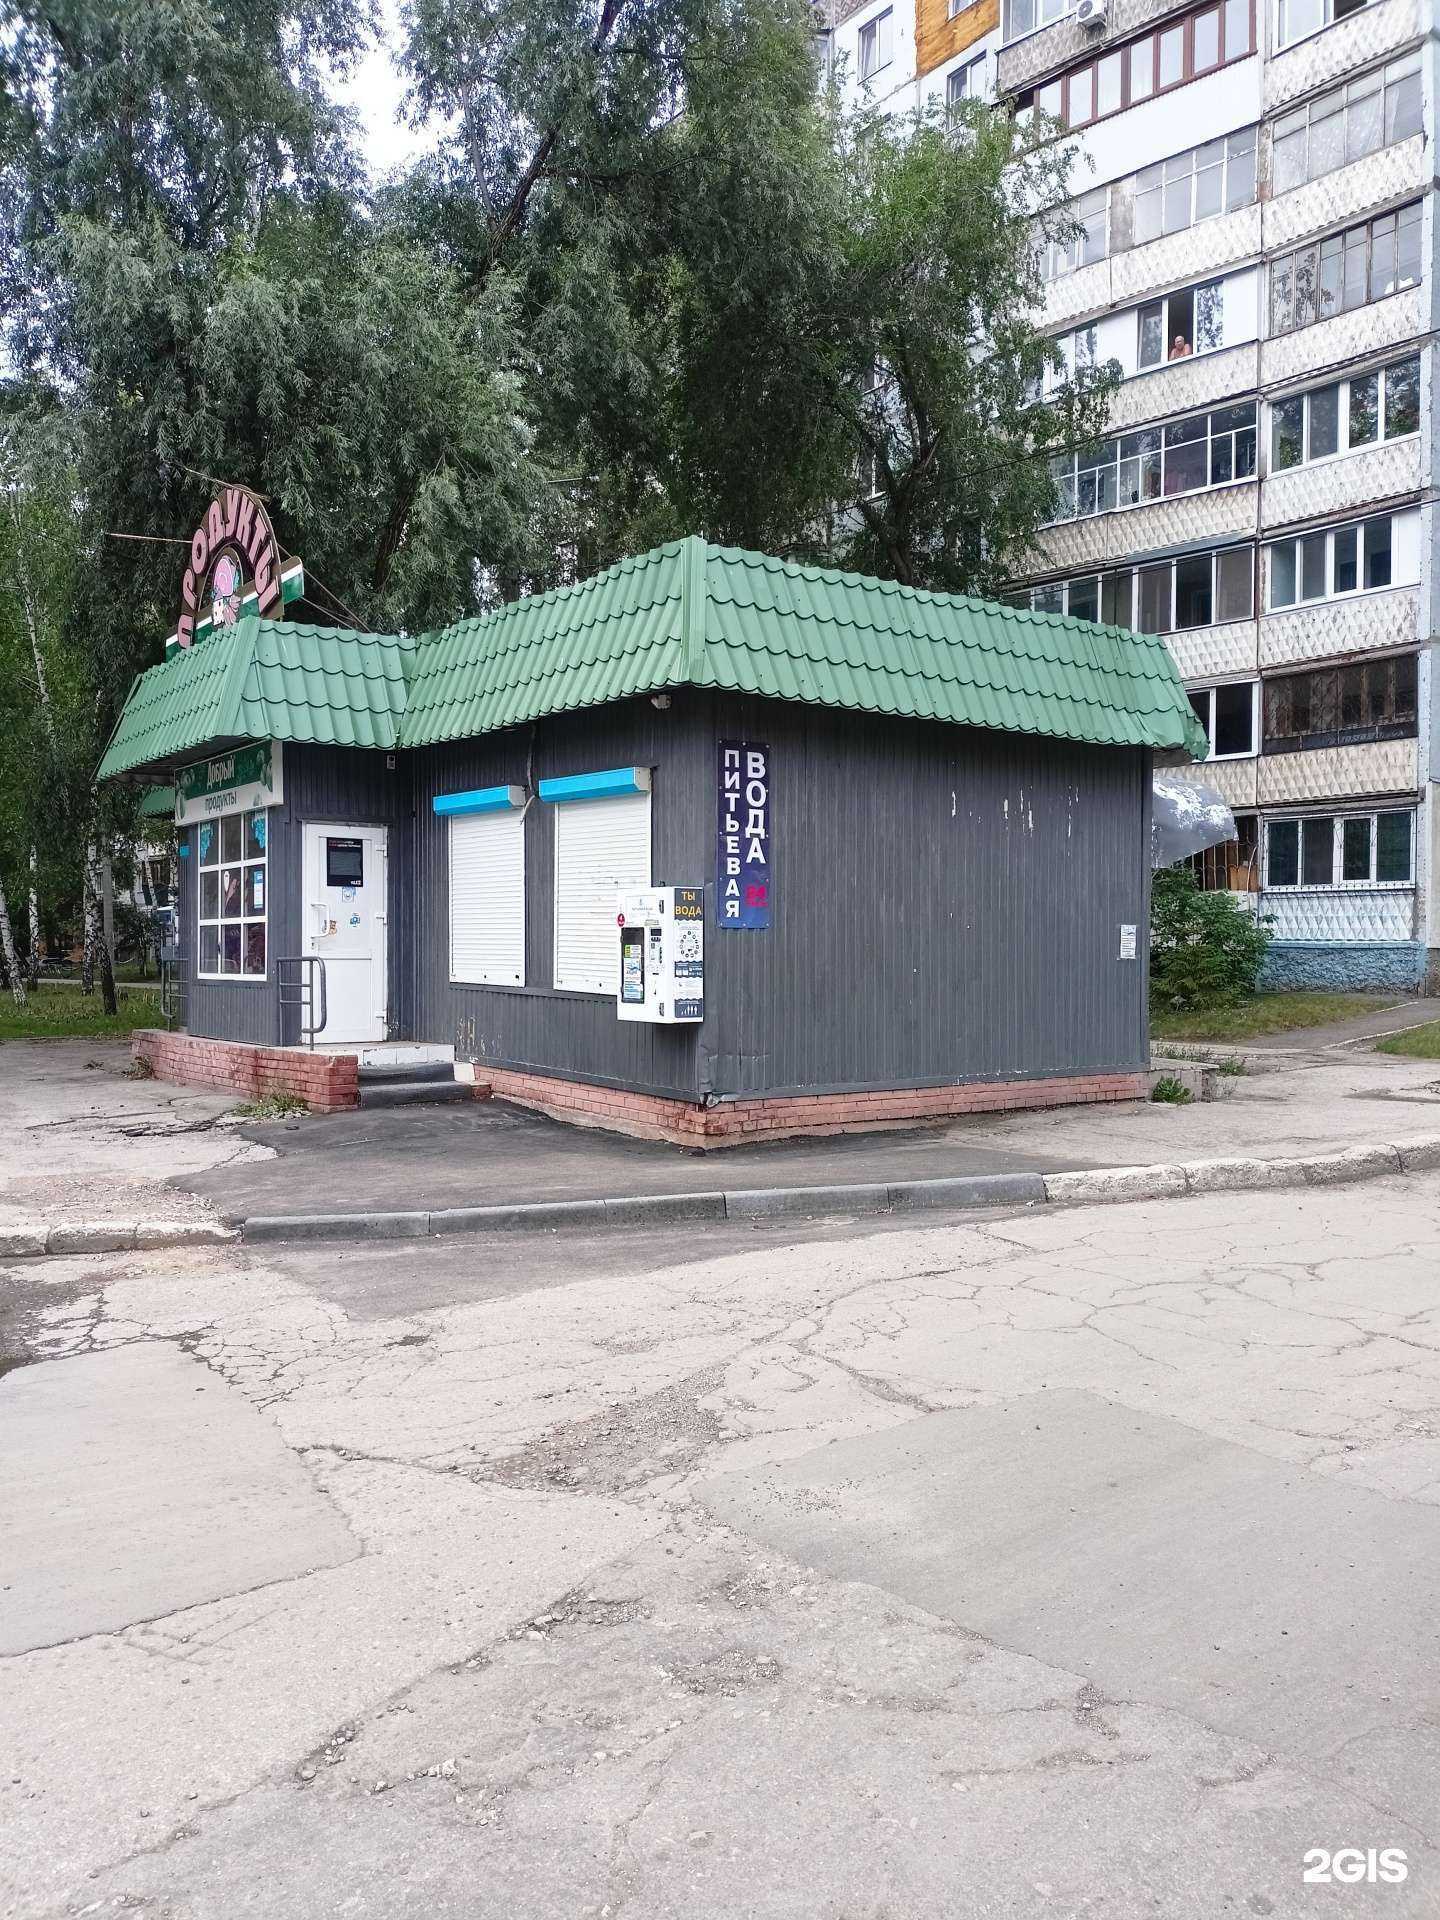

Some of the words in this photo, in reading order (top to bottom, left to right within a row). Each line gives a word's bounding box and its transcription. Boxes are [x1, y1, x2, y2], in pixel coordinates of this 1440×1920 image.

[177, 488, 280, 649] ПРОДУКТЫ
[724, 749, 741, 918] ПИТЬЕВАЯ
[745, 751, 767, 864] ВОДА
[675, 905, 702, 918] ВОДА
[681, 891, 696, 901] ТЫ
